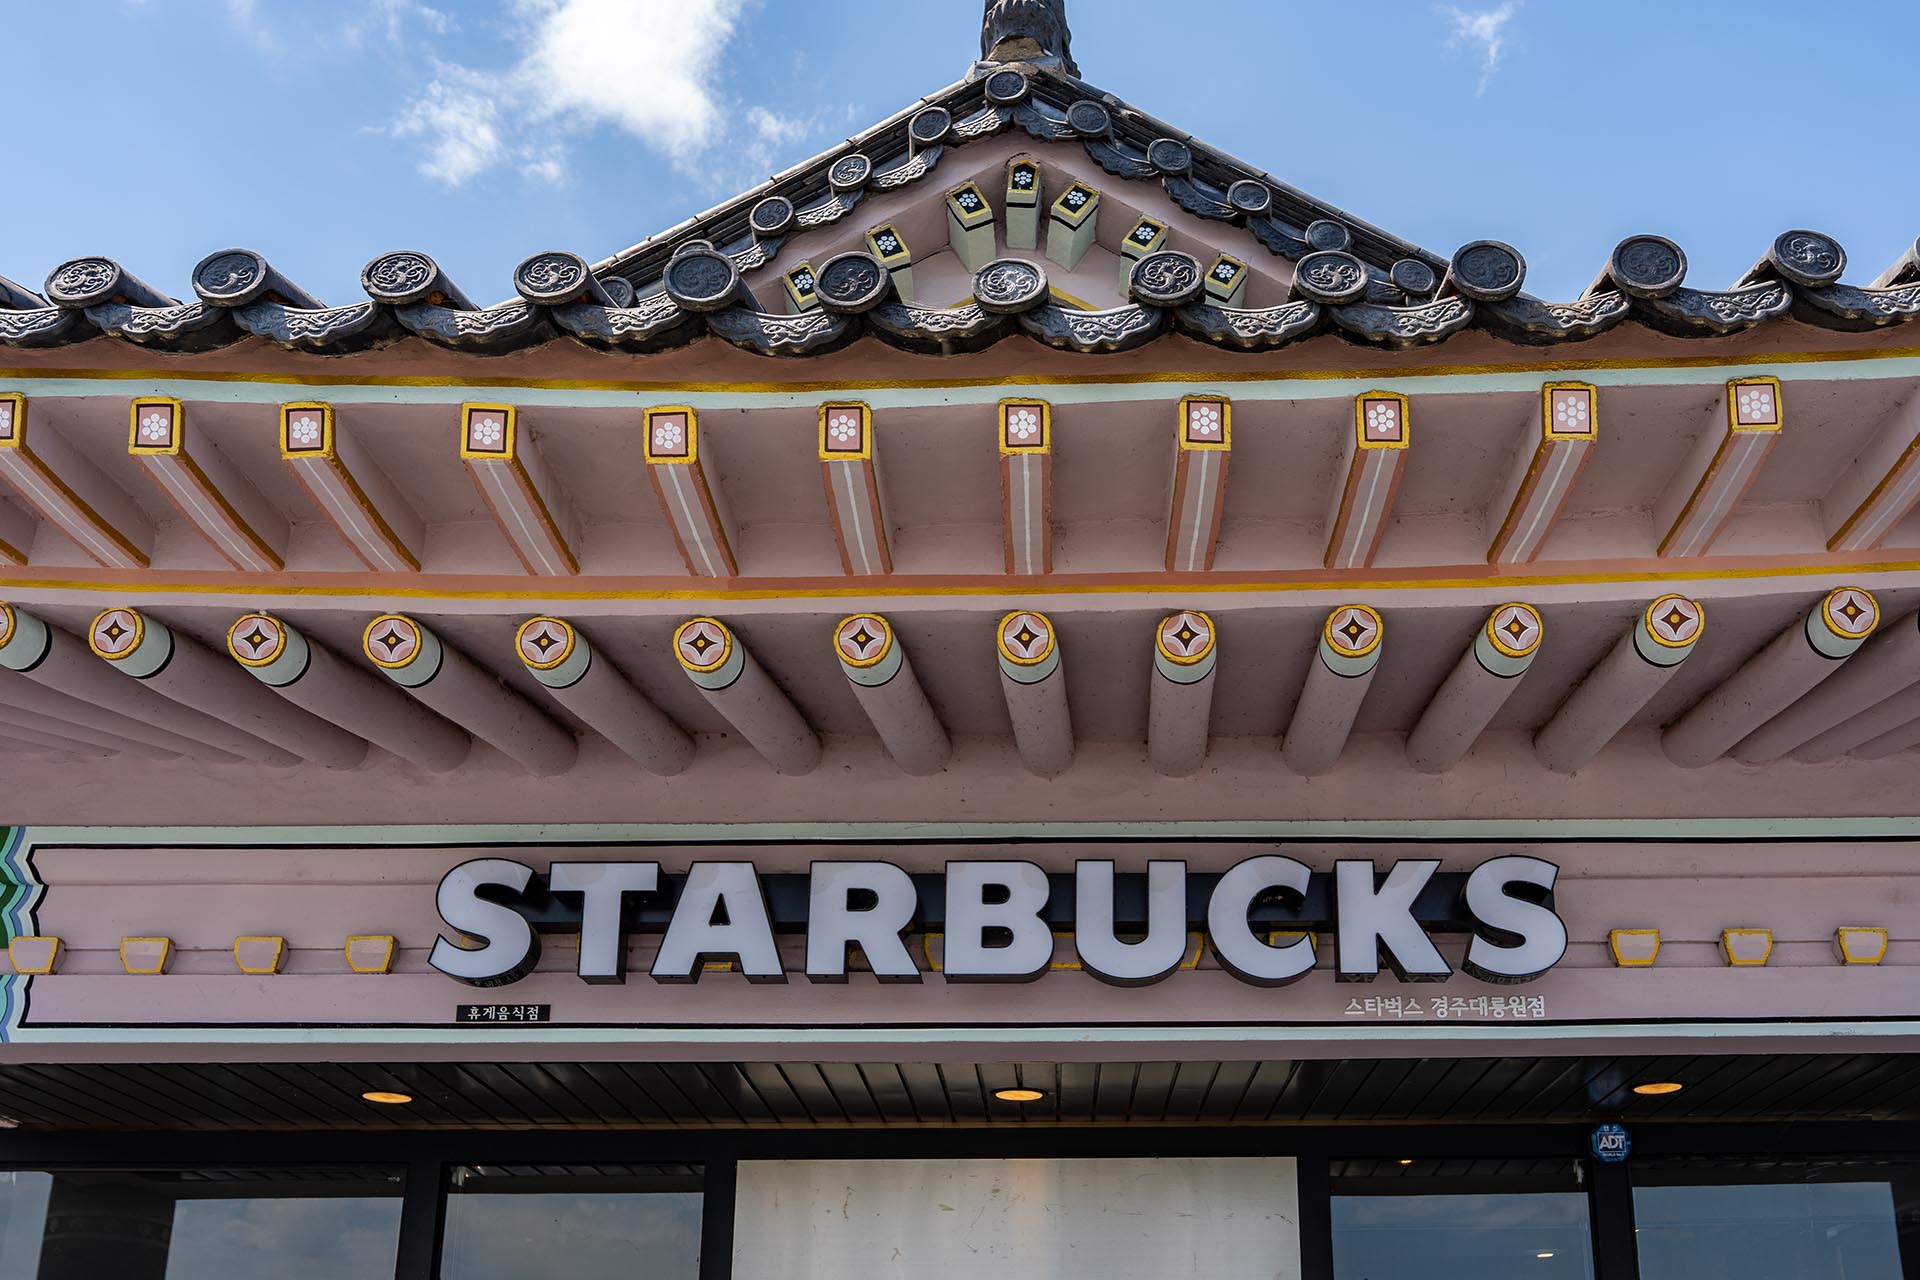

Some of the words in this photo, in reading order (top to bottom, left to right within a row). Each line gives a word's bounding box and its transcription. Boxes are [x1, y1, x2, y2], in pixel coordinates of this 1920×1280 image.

[427, 857, 1568, 985] STARBUCKS
[467, 1006, 539, 1021] 휴게음식점
[1344, 997, 1424, 1018] 스타벅스
[1431, 996, 1546, 1018] 경주대릉원점
[1599, 1135, 1625, 1149] ADT
